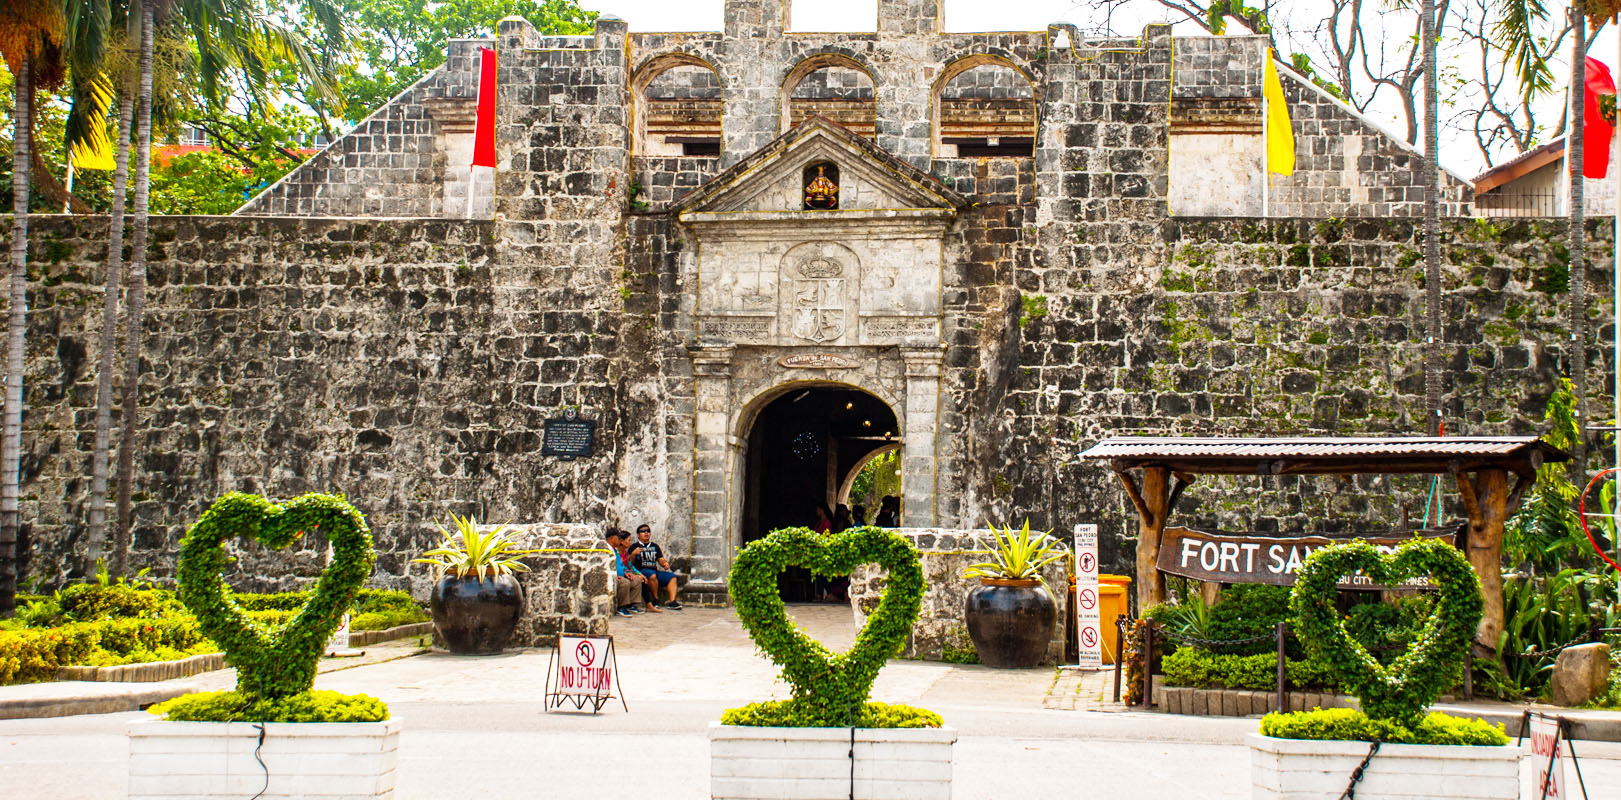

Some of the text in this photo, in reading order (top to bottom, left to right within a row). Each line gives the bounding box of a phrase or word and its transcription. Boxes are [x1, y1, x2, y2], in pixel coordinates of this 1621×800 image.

[1181, 537, 1260, 573] FORT
[1336, 575, 1373, 585] BU CITY
[561, 666, 611, 690] NO U-TURN
